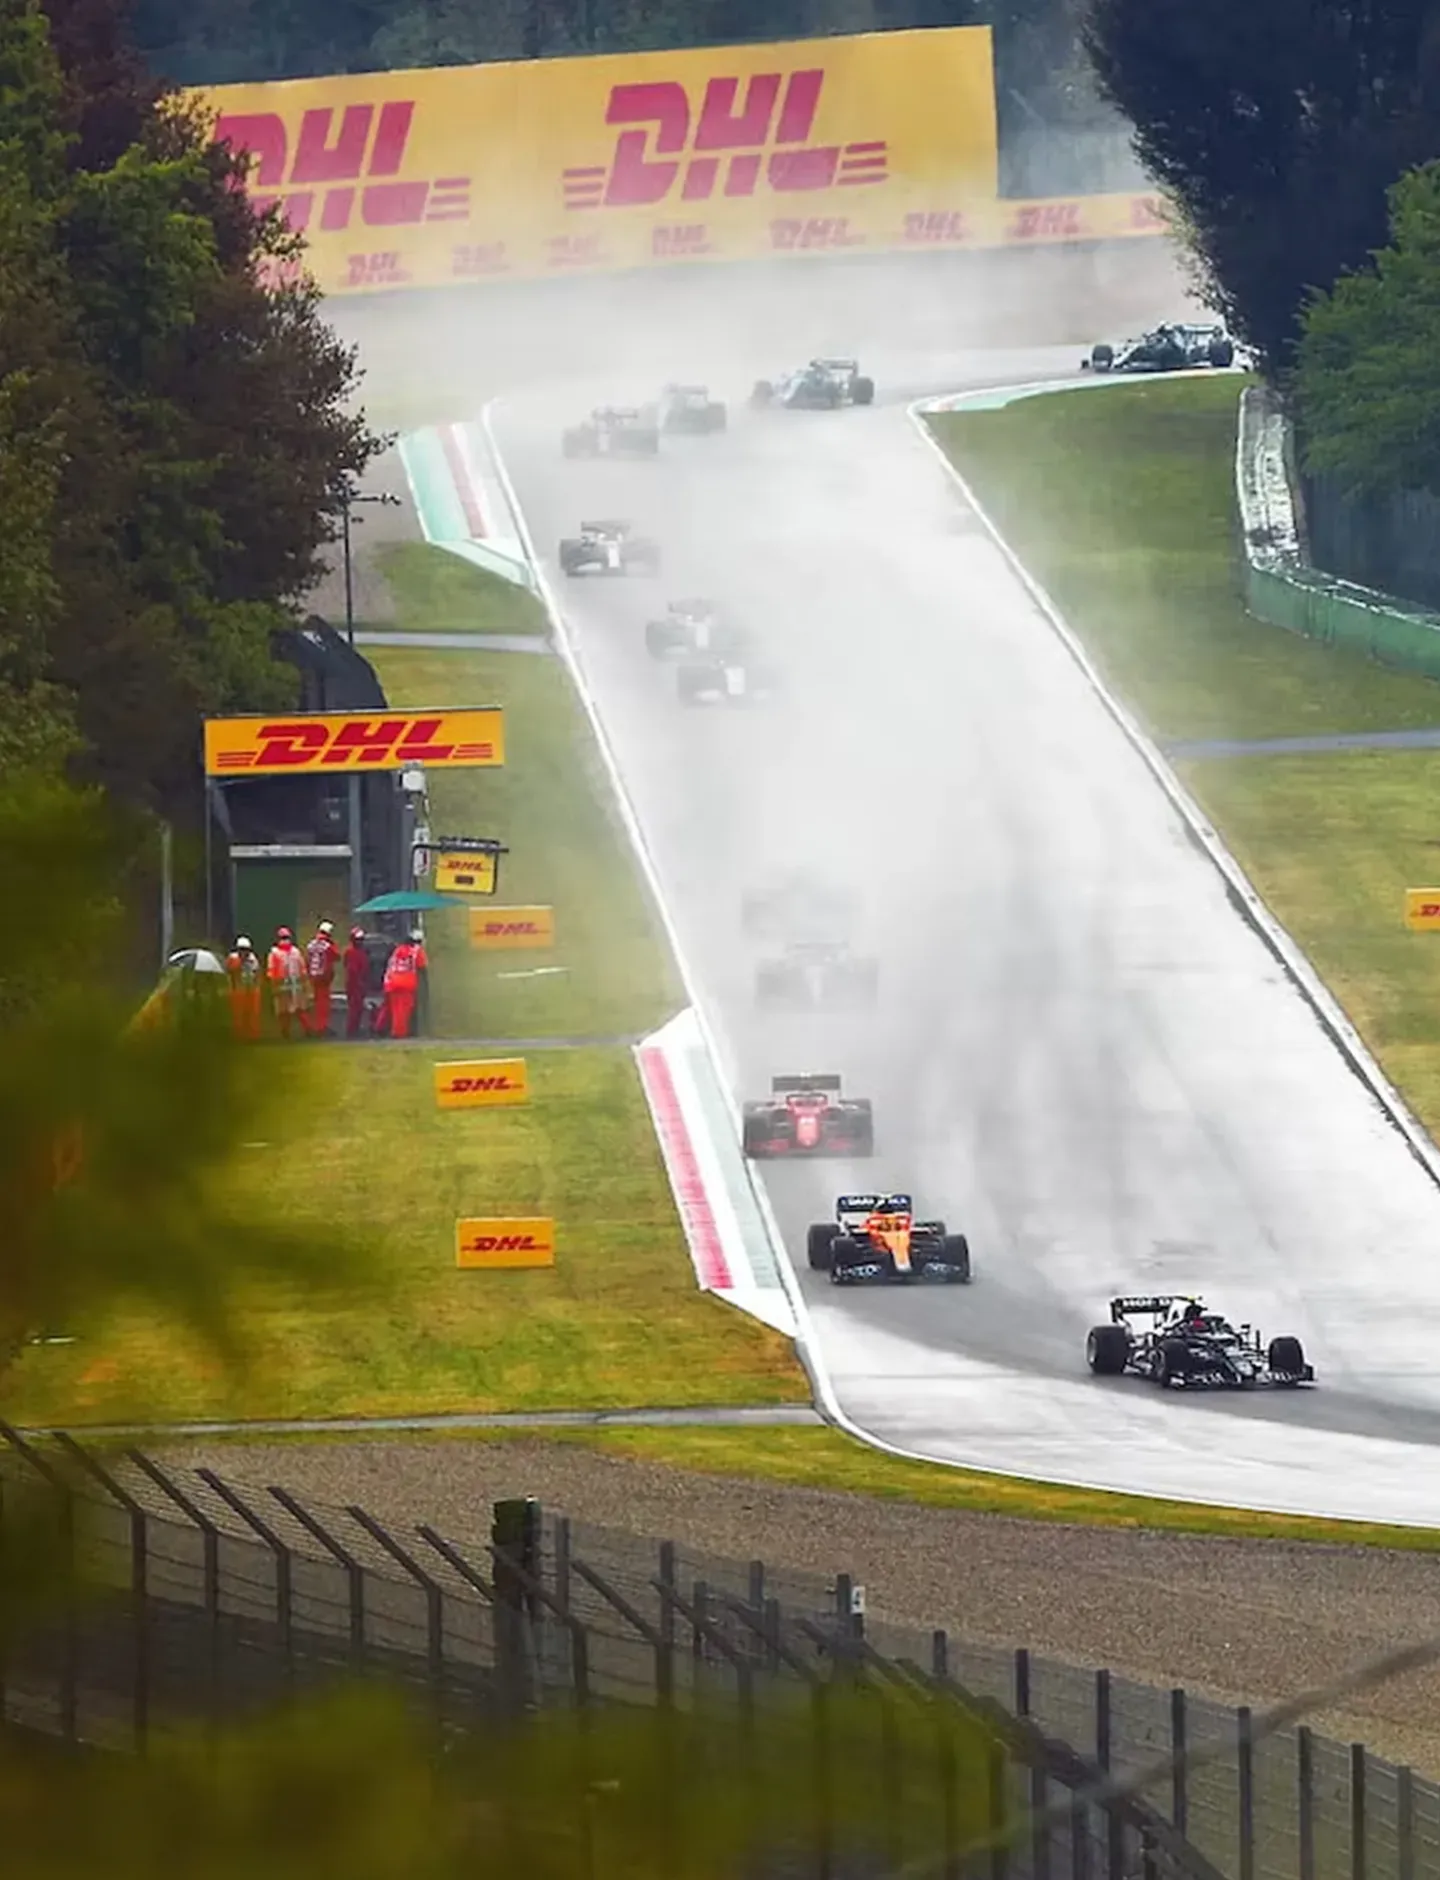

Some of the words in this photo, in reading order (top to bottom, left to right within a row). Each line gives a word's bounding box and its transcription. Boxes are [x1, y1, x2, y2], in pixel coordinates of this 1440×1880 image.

[604, 68, 839, 205] DHL
[213, 101, 430, 231] DHL
[255, 720, 454, 766] DHL
[485, 922, 538, 936] DHL
[450, 1077, 511, 1093] DHL
[473, 1236, 535, 1252] DHL
